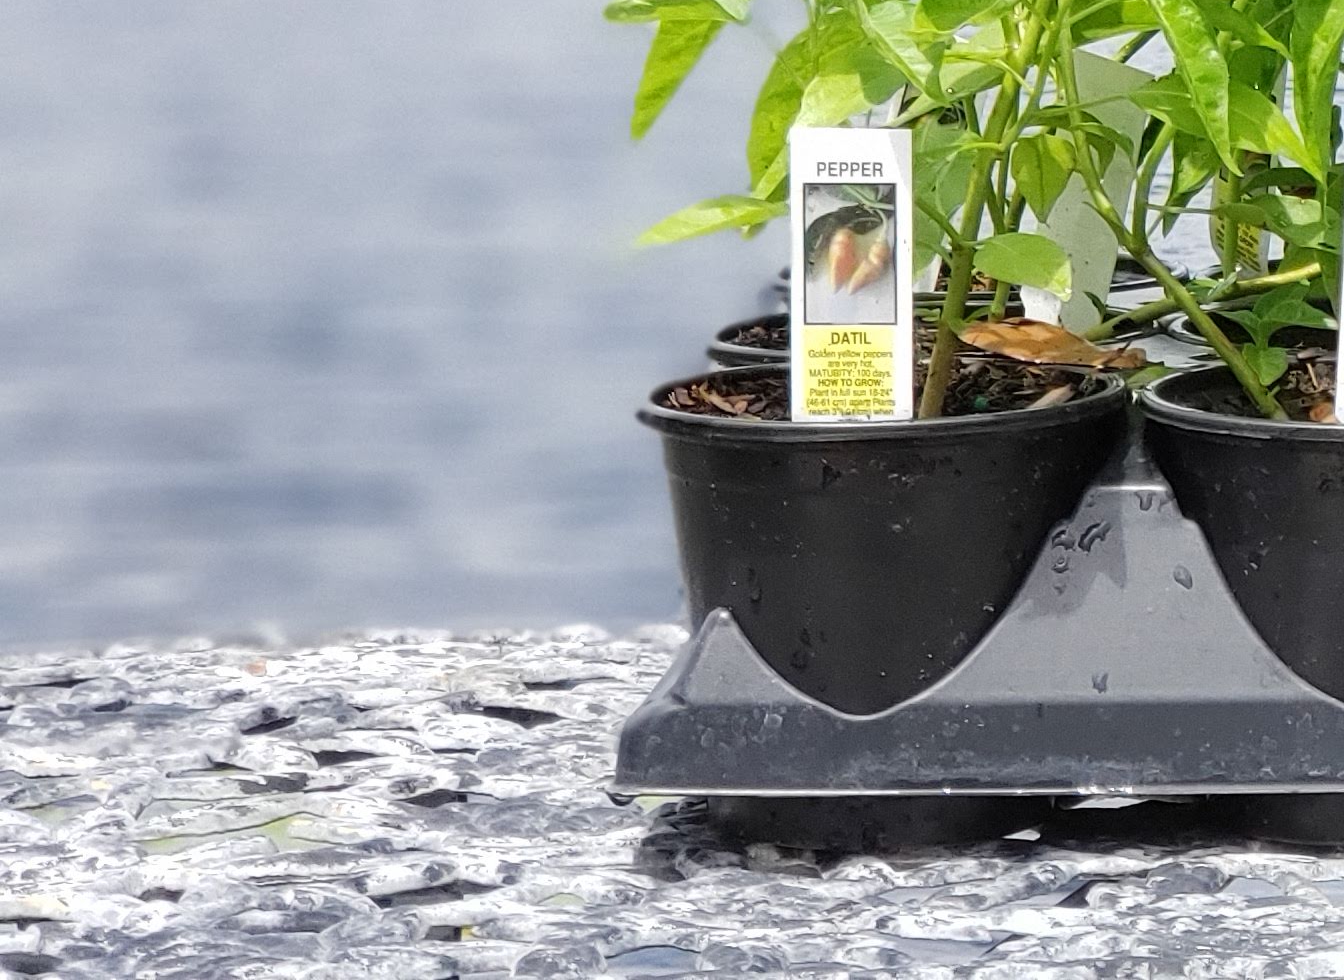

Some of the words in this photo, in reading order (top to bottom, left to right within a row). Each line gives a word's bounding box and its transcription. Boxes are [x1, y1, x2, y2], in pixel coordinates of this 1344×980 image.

[817, 162, 883, 177] PEPPER
[831, 332, 871, 344] DATIL
[842, 361, 857, 369] very
[818, 379, 838, 387] HOW
